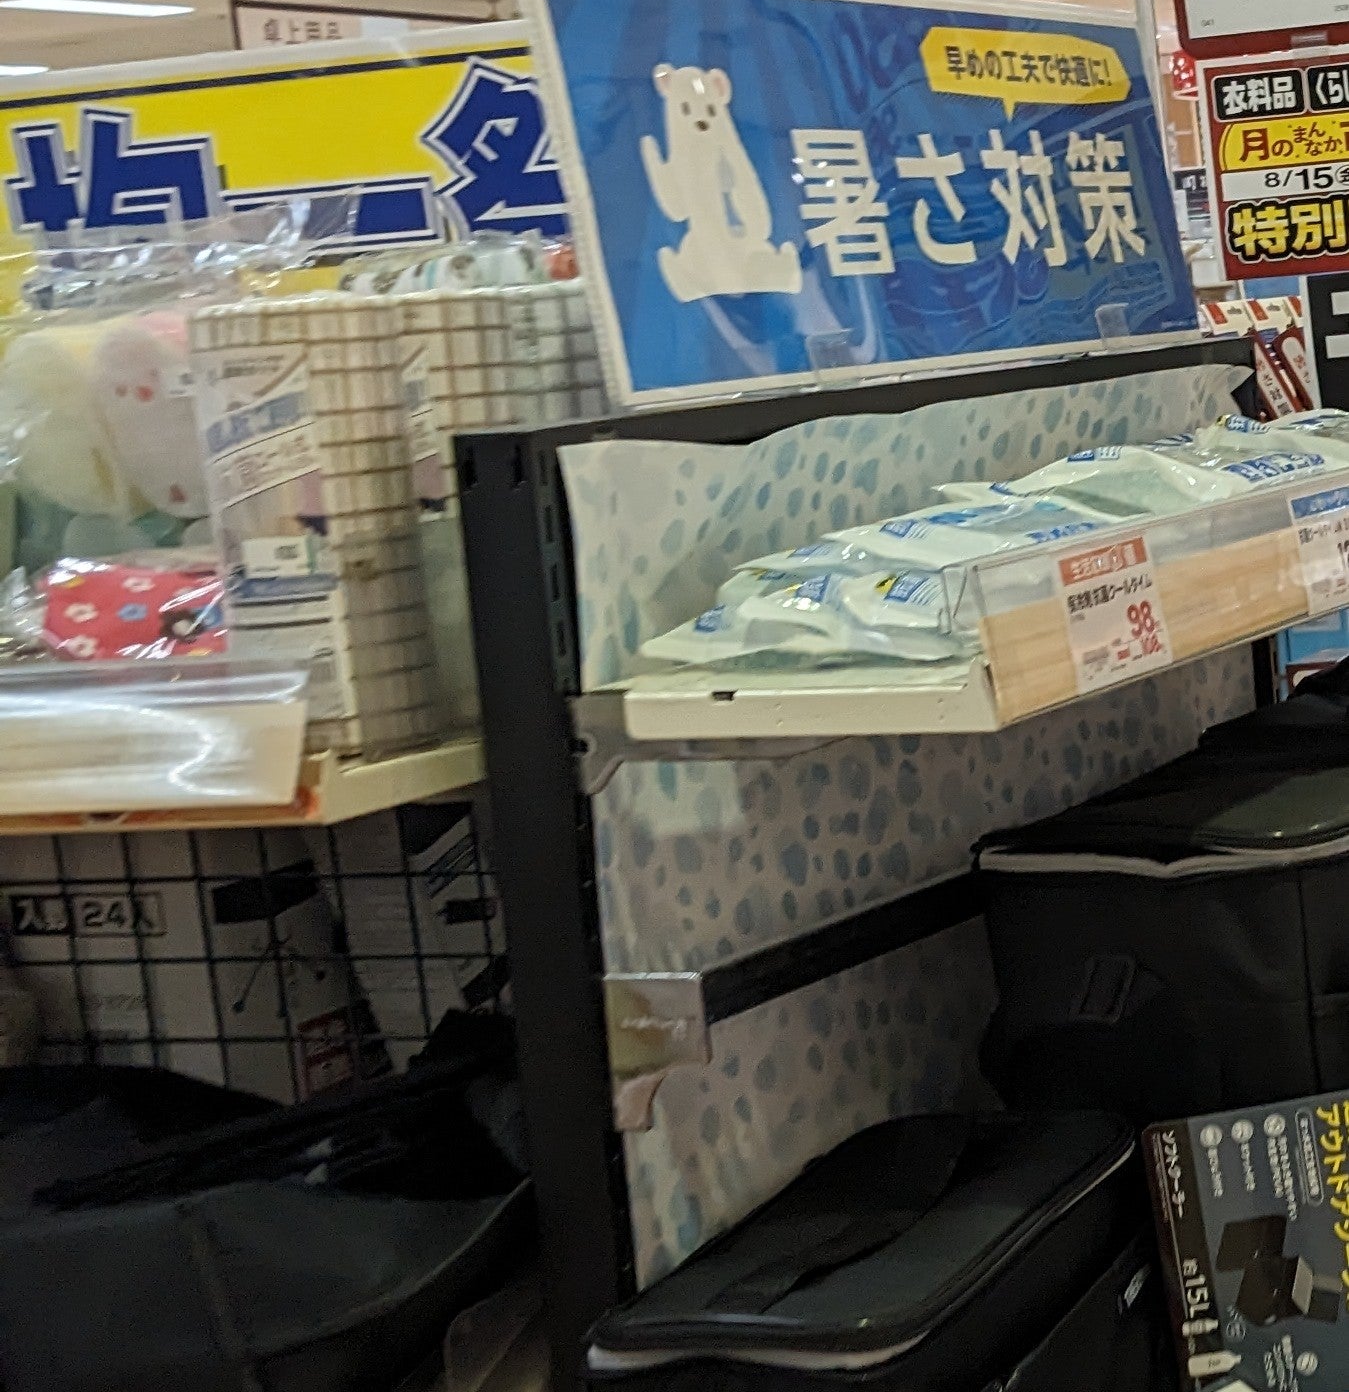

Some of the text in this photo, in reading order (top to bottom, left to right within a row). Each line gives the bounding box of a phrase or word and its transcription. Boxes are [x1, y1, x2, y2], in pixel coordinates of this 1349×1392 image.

[945, 43, 1113, 88] 早めの工夫で快適に!
[1222, 75, 1297, 115] 衣料品
[1239, 127, 1294, 163] 月の
[790, 128, 1147, 277] 暑さ対策
[1232, 199, 1347, 257] 特別
